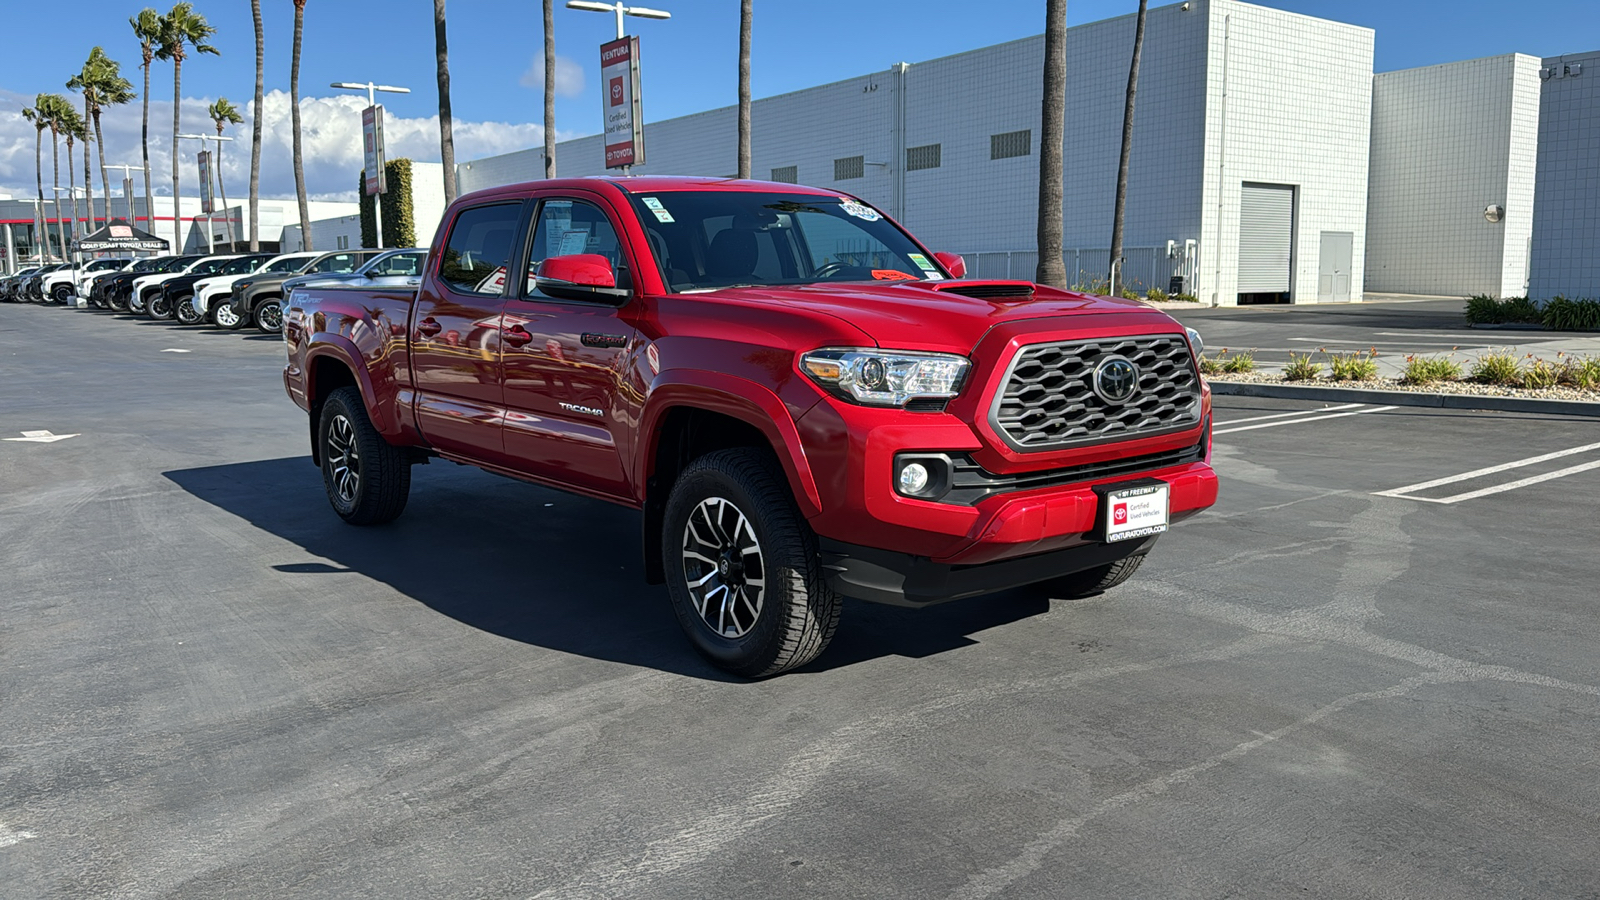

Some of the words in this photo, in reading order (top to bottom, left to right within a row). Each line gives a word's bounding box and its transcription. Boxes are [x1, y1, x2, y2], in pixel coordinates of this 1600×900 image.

[602, 45, 629, 61] VENTURA
[609, 111, 627, 122] Certified
[613, 148, 633, 159] TOYOTA
[559, 402, 604, 417] TACOMA
[1130, 487, 1154, 495] FREEWAY
[1130, 502, 1150, 511] Certified
[1142, 509, 1160, 517] Vehicles
[1109, 525, 1166, 541] VENTURATOYOTA.COM
